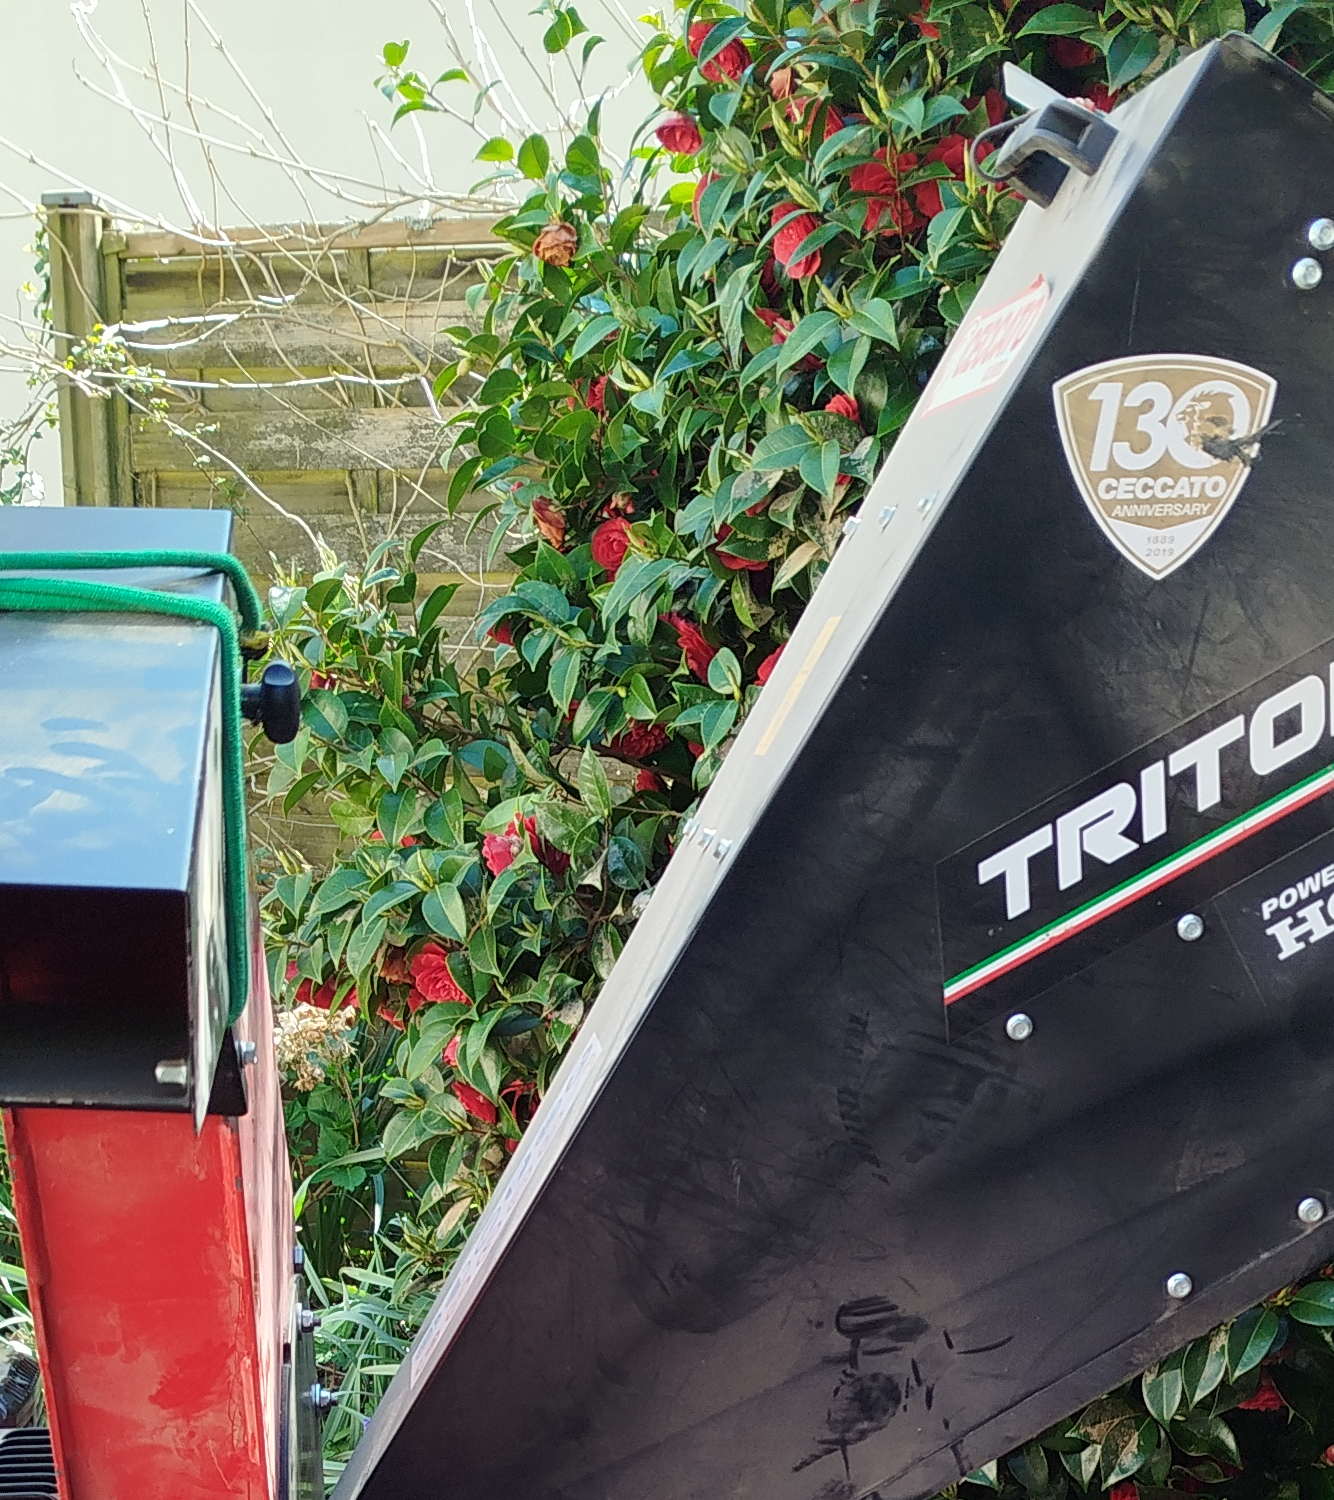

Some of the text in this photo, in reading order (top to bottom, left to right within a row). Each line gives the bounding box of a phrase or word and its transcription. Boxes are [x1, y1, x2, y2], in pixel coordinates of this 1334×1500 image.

[1087, 380, 1251, 472] 130
[1097, 476, 1228, 500] CECCATO
[1111, 503, 1212, 517] ANNIVERSARY
[1145, 547, 1175, 557] 2019
